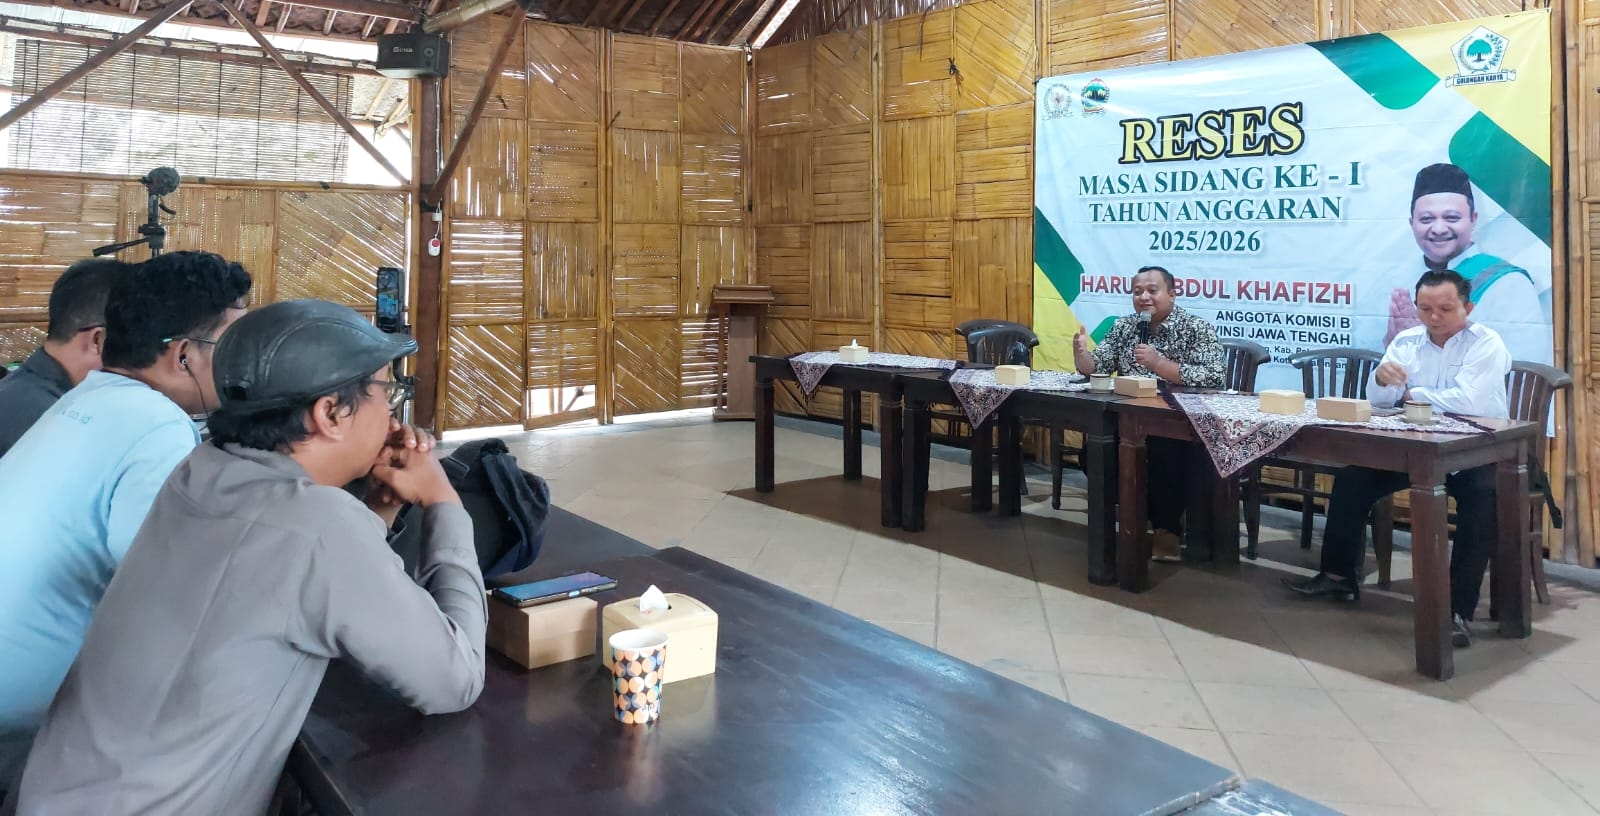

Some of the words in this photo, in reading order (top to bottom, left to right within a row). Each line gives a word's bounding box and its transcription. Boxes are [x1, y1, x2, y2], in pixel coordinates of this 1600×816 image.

[1118, 102, 1305, 164] RESES
[1079, 173, 1148, 196] MASA
[1154, 166, 1264, 193] SIDANG
[1273, 163, 1319, 188] KE
[1348, 161, 1361, 186] I
[1088, 201, 1169, 222] TAHUN
[1175, 196, 1342, 221] ANGGARAN
[1149, 229, 1261, 251] 2025/2026
[1081, 275, 1133, 295] HARU
[1174, 278, 1231, 299] BDUL
[1237, 280, 1351, 305] KHAFIZH
[1216, 310, 1282, 325] ANGGOTA
[1285, 314, 1335, 328] KOMISI
[1340, 317, 1350, 329] B
[1248, 327, 1286, 341] JAWA
[1290, 330, 1350, 345] TENGAH
